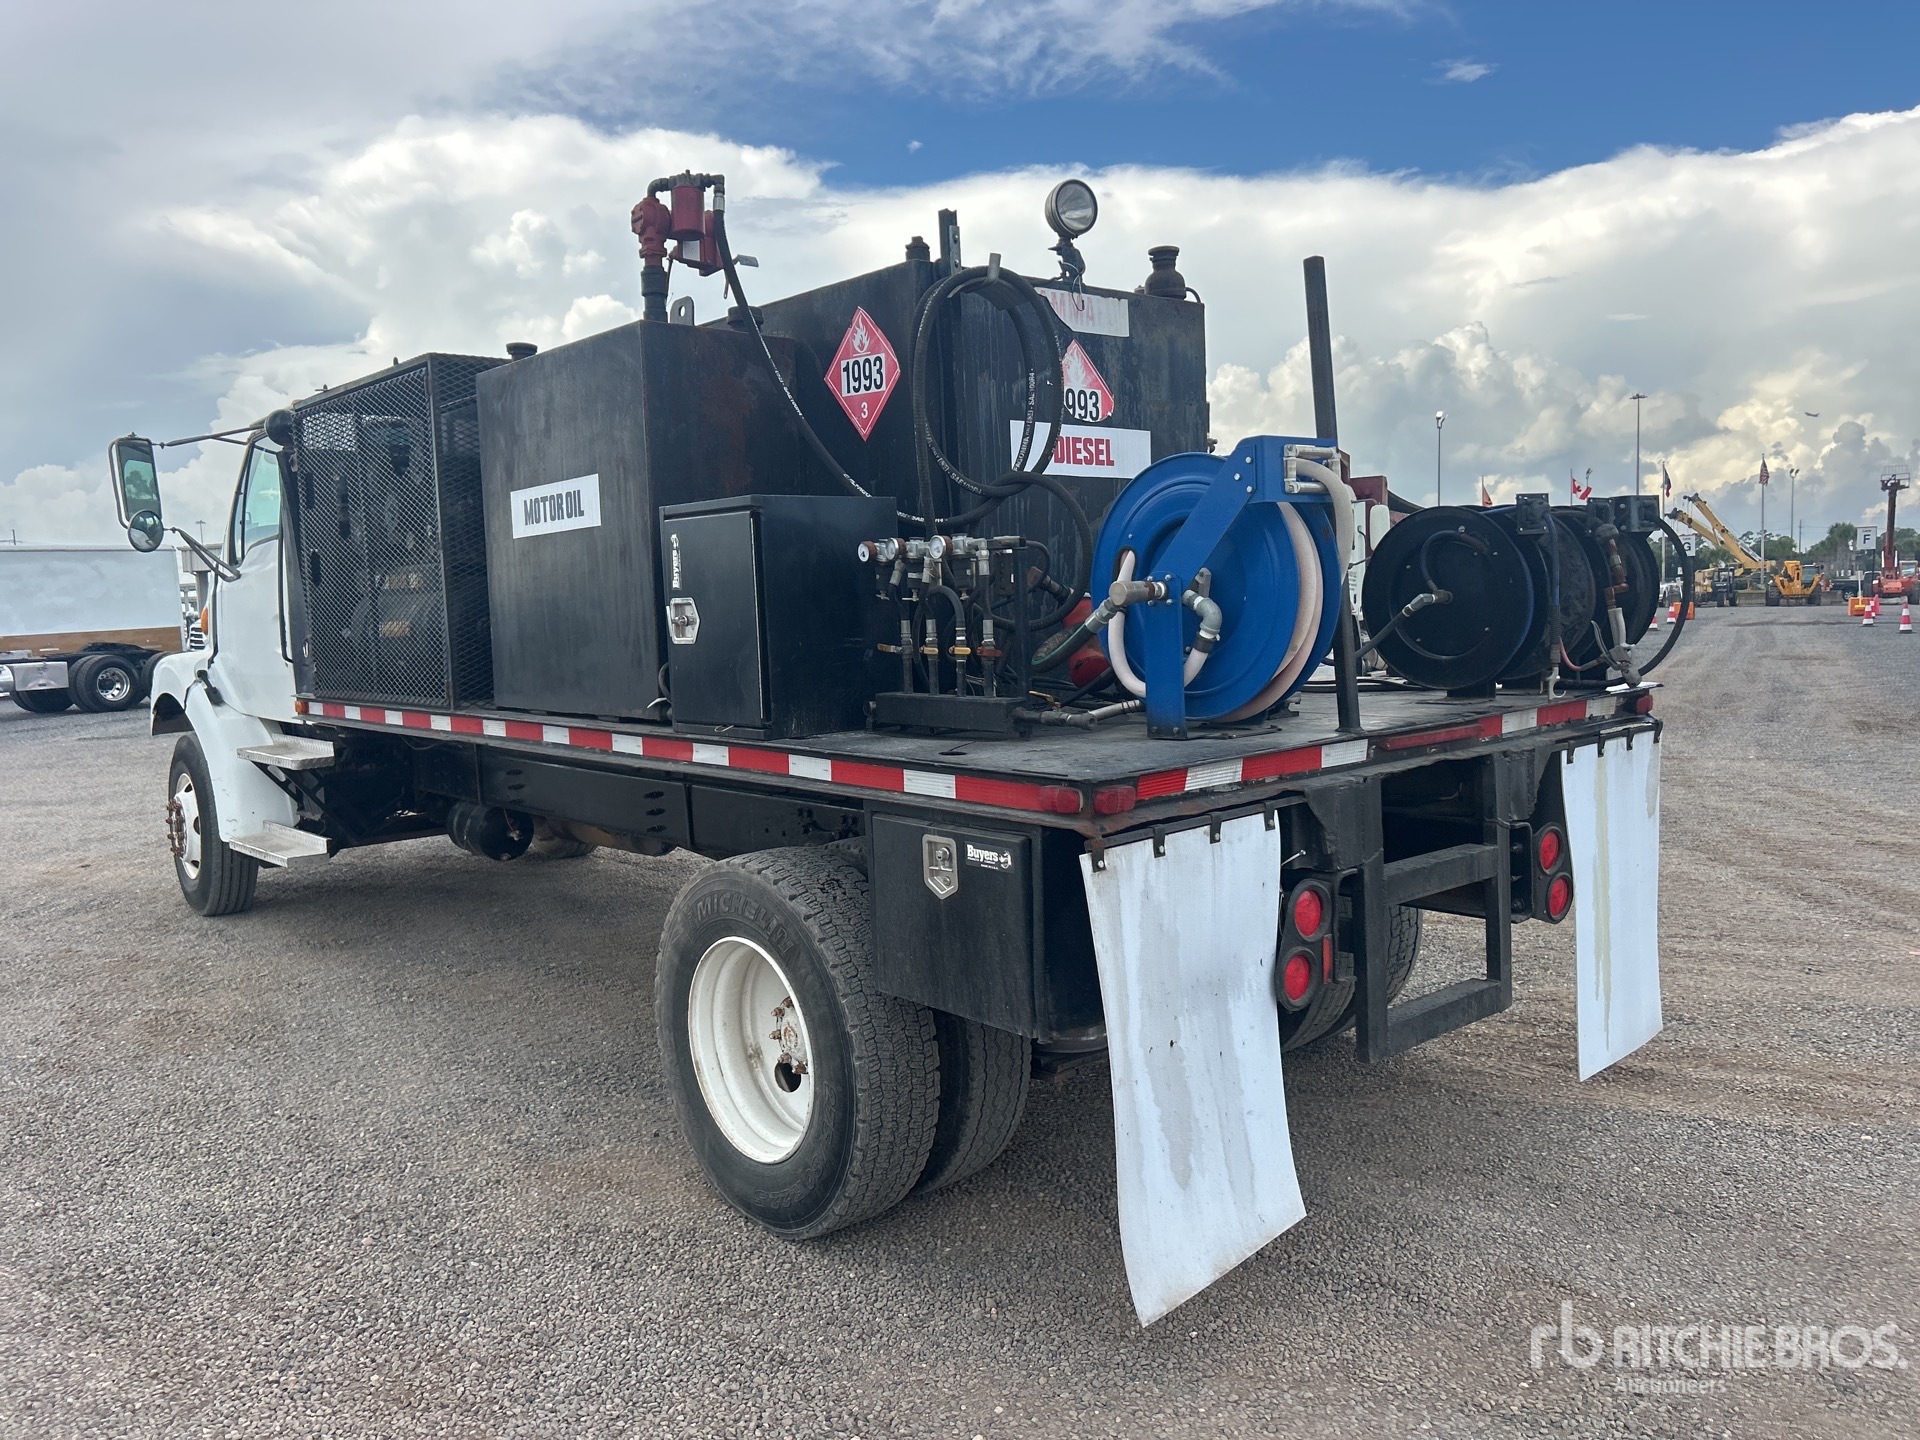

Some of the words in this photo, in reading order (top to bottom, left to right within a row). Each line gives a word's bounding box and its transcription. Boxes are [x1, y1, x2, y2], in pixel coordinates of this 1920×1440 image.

[841, 355, 885, 395] 1993
[861, 402, 868, 419] 3
[1064, 390, 1100, 422] 993
[1053, 435, 1115, 467] DIESEL
[523, 493, 565, 526] MOTOR
[565, 489, 585, 519] OIL
[1683, 541, 1692, 552] G
[1863, 534, 1871, 545] F
[672, 549, 680, 588] Buyers
[966, 843, 999, 863] Buyers
